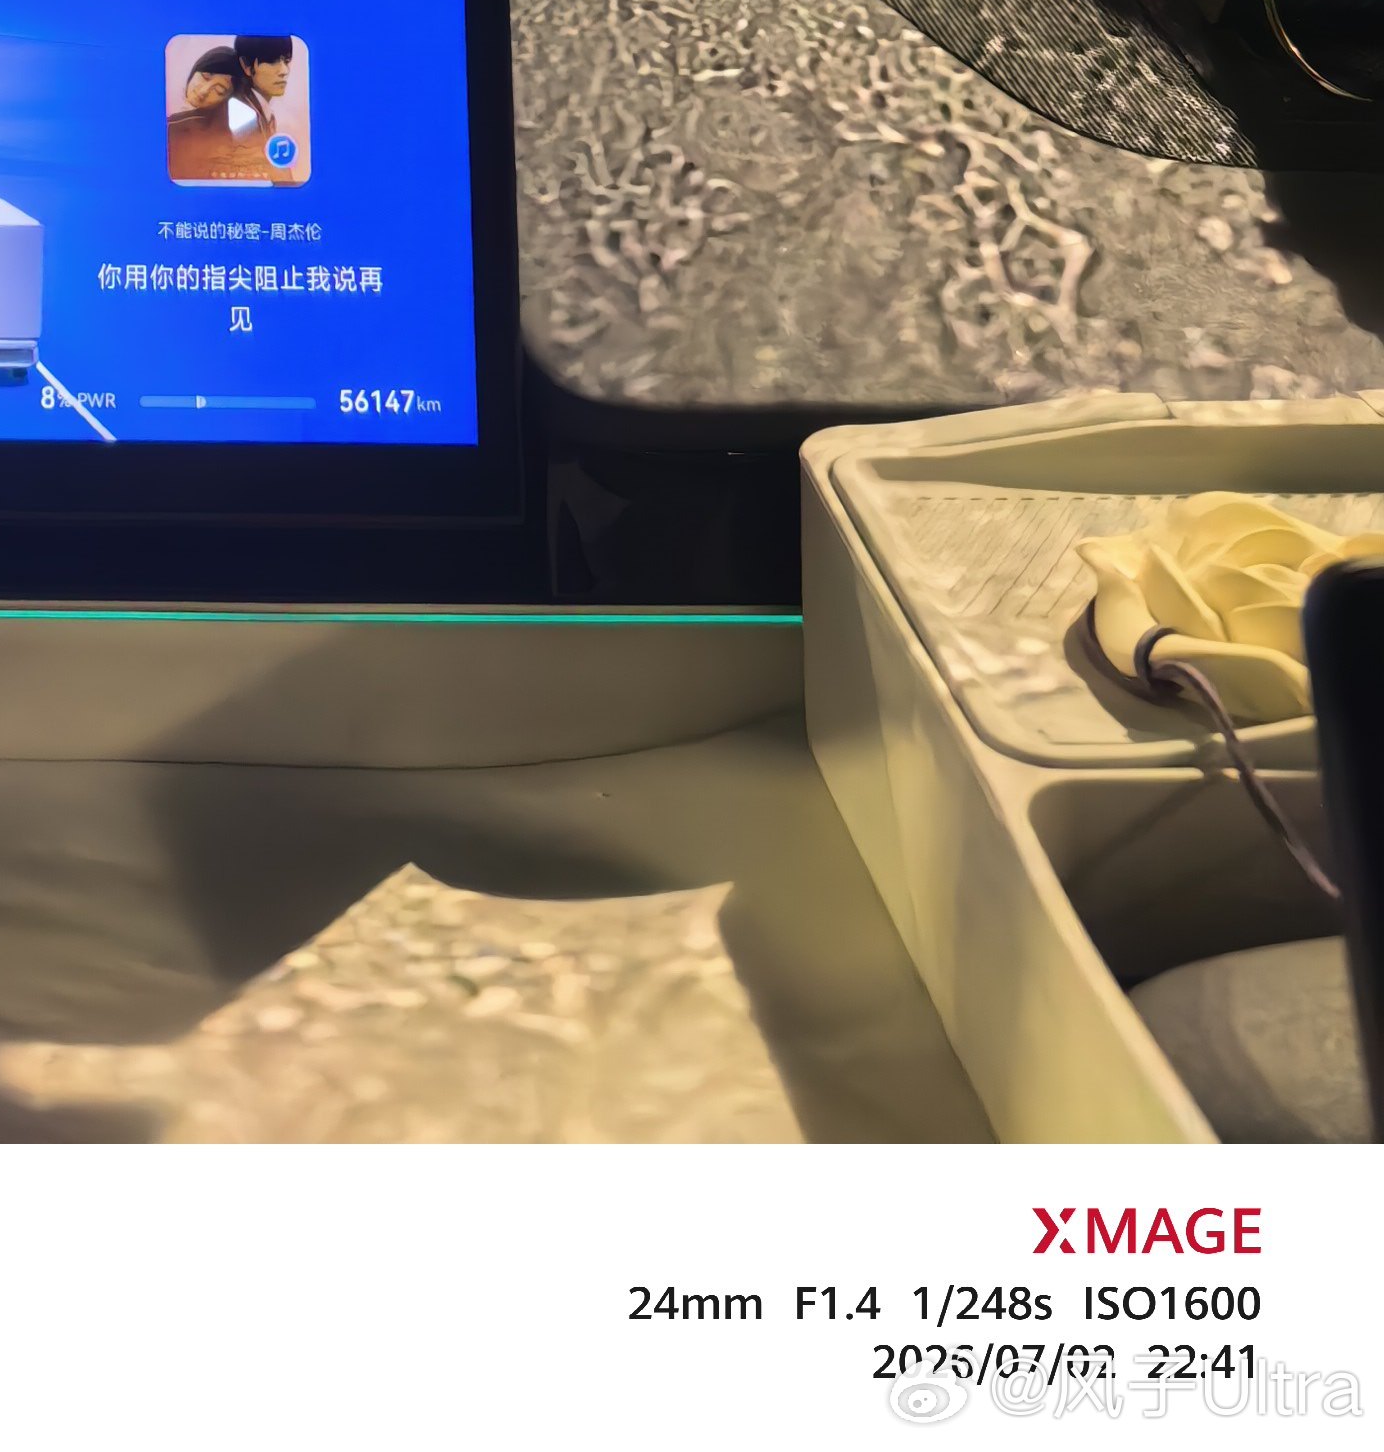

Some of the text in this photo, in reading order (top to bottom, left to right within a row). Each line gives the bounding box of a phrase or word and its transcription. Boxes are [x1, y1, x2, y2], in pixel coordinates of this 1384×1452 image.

[157, 220, 323, 242] 不能说的秘密-周杰伦
[96, 262, 384, 293] 你用你的指尖阻止我说再
[228, 305, 254, 333] 见
[77, 392, 116, 409] PWR
[339, 388, 442, 415] 56147km
